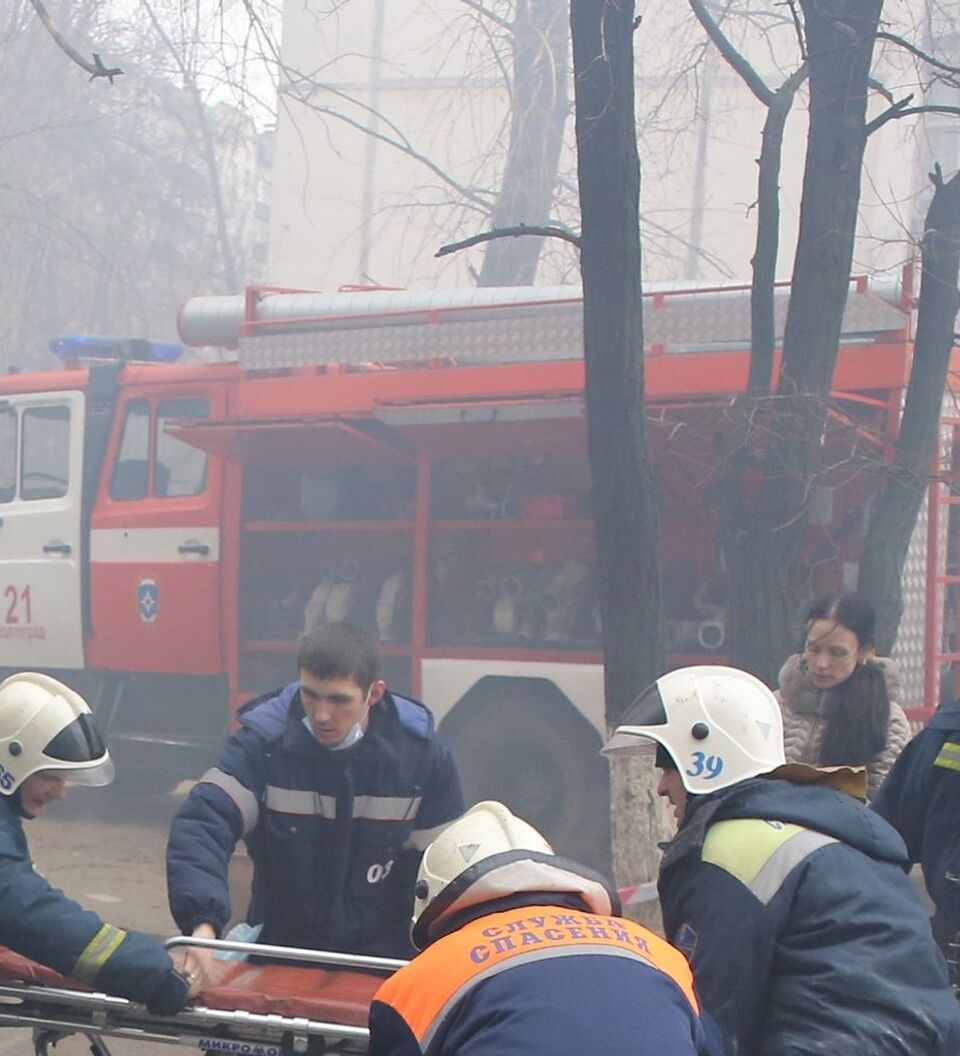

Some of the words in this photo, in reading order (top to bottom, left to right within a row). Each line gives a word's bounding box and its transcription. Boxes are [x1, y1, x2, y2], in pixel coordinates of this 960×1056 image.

[5, 585, 31, 624] 21
[686, 752, 723, 779] 39
[482, 914, 627, 938] СЛУЖБА
[470, 926, 652, 964] СПАСЕНИЯ
